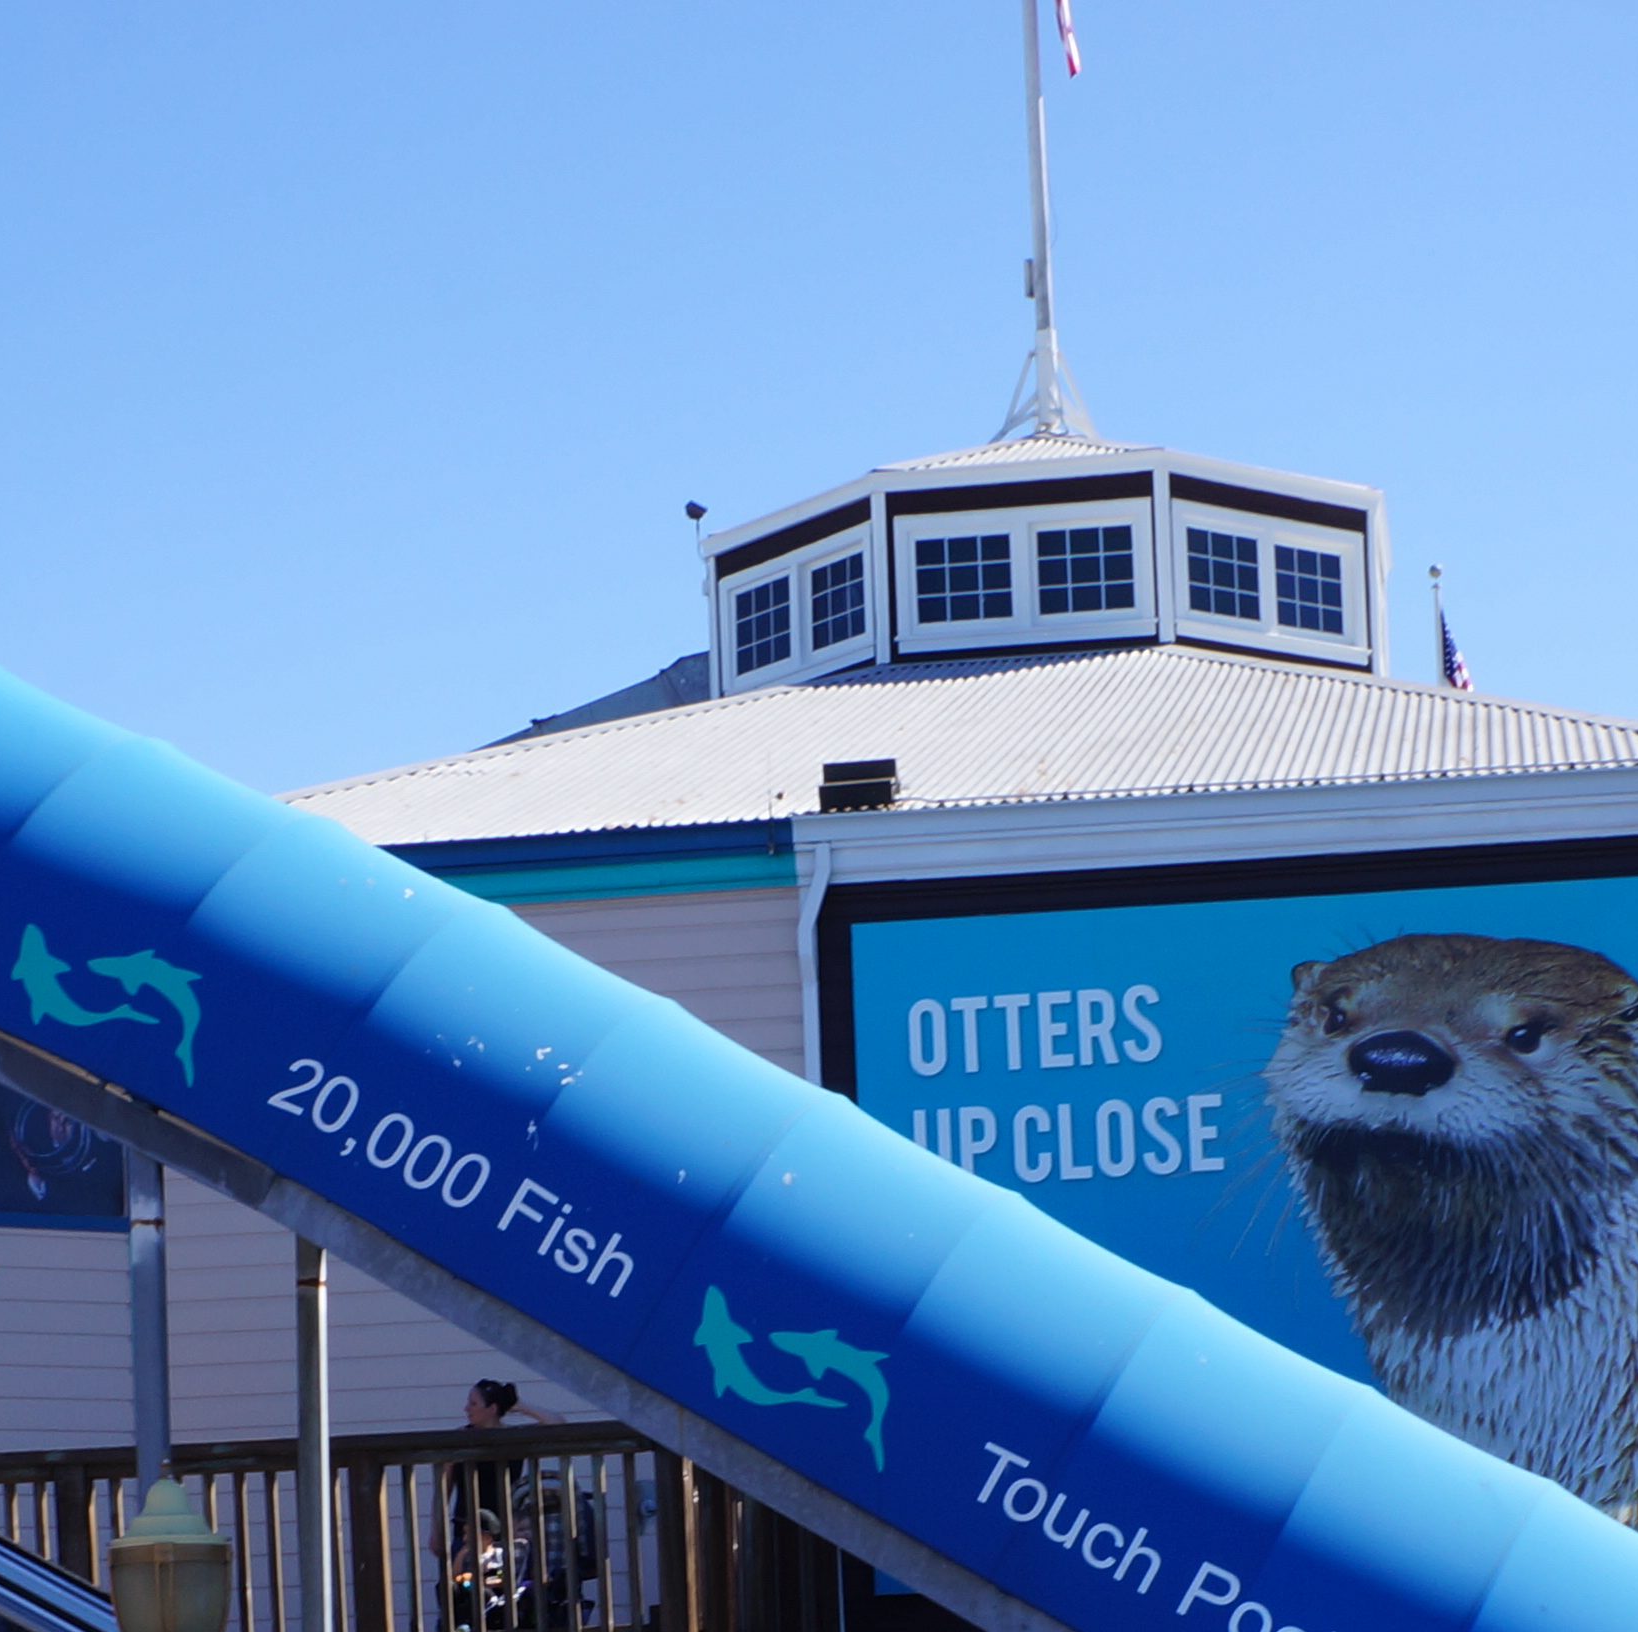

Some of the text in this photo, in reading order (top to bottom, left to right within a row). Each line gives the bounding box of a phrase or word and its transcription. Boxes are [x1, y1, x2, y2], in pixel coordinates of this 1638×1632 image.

[907, 983, 1163, 1077] OTTERS
[269, 1057, 635, 1298] 20,000 Fish
[1012, 1093, 1226, 1184] CLOSE
[977, 1441, 1164, 1596] Touch
